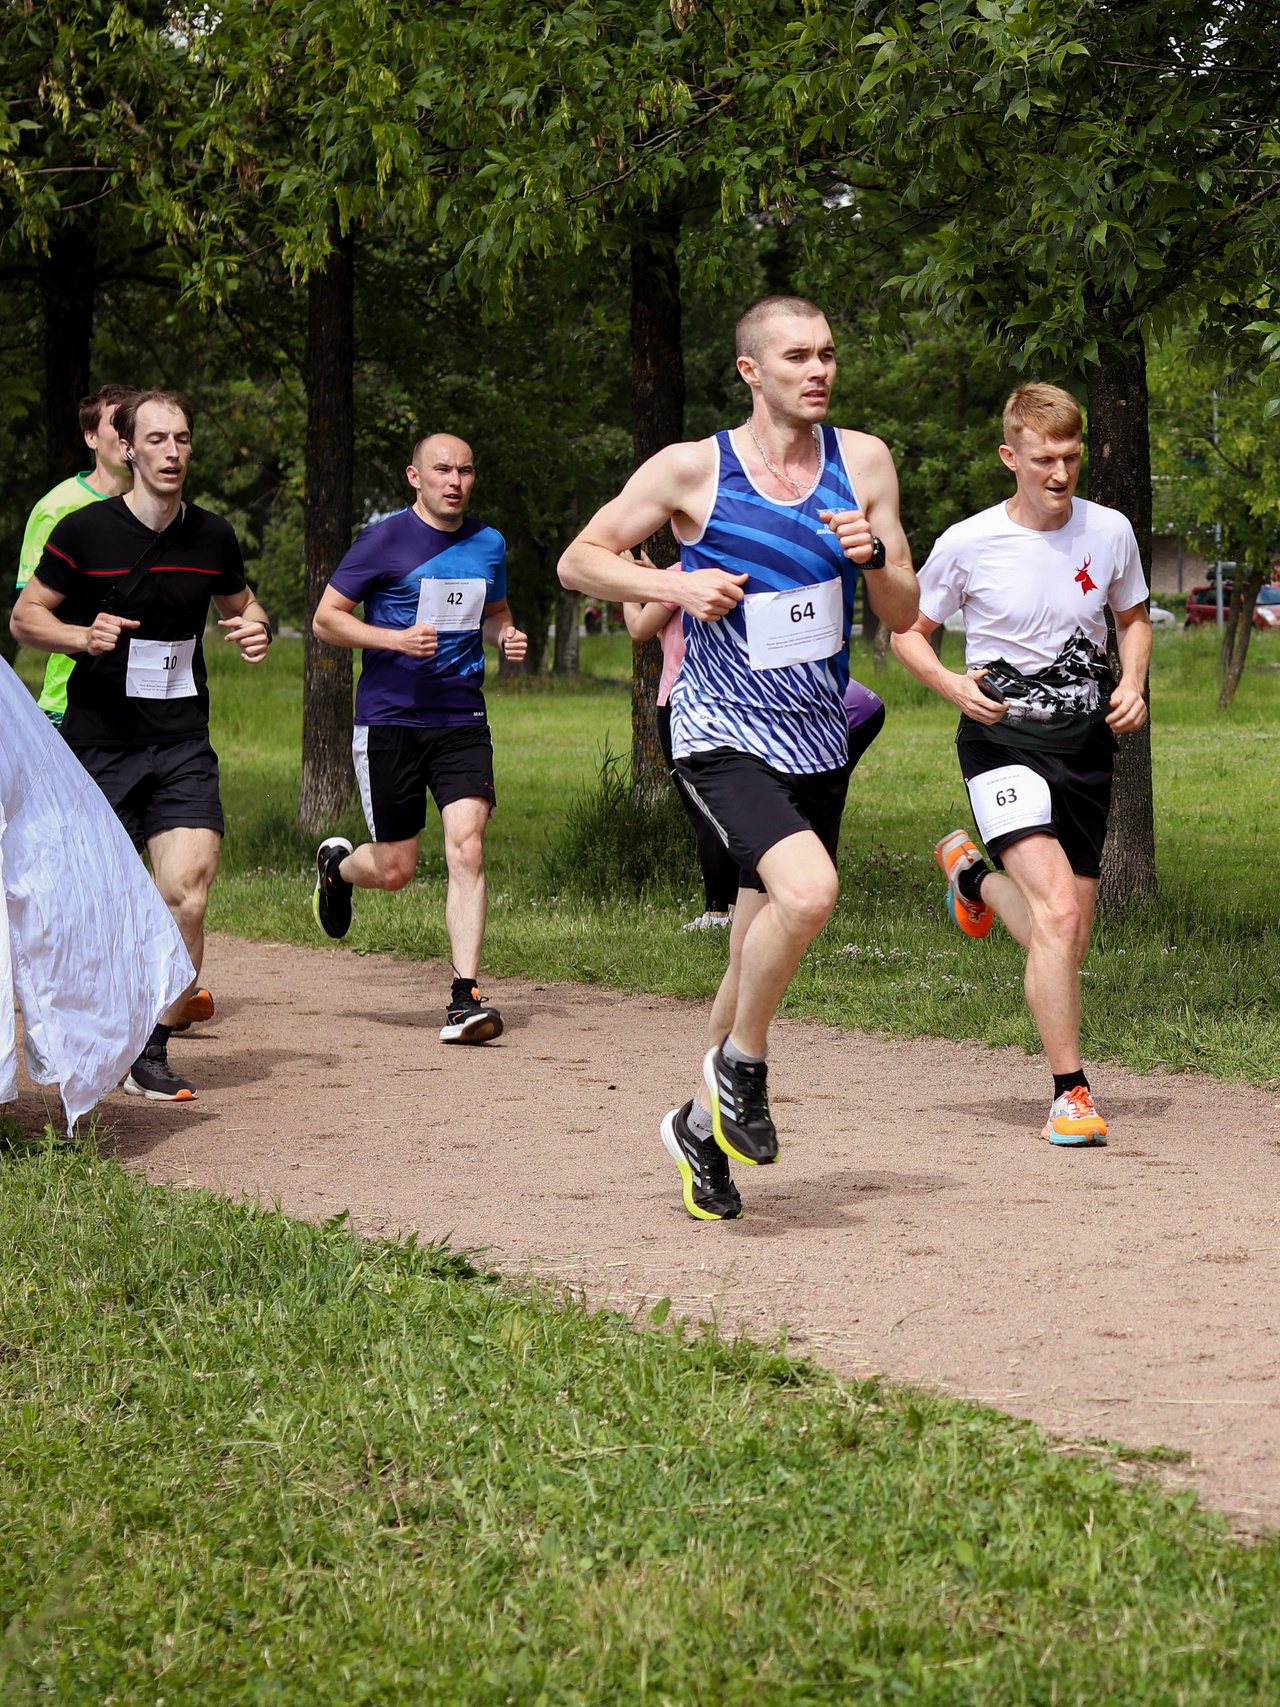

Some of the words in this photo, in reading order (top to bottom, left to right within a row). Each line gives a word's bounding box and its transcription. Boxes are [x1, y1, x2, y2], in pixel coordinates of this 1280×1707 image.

[446, 592, 463, 605] 42
[789, 601, 816, 623] 64
[162, 655, 178, 670] 10
[995, 787, 1018, 807] 63
